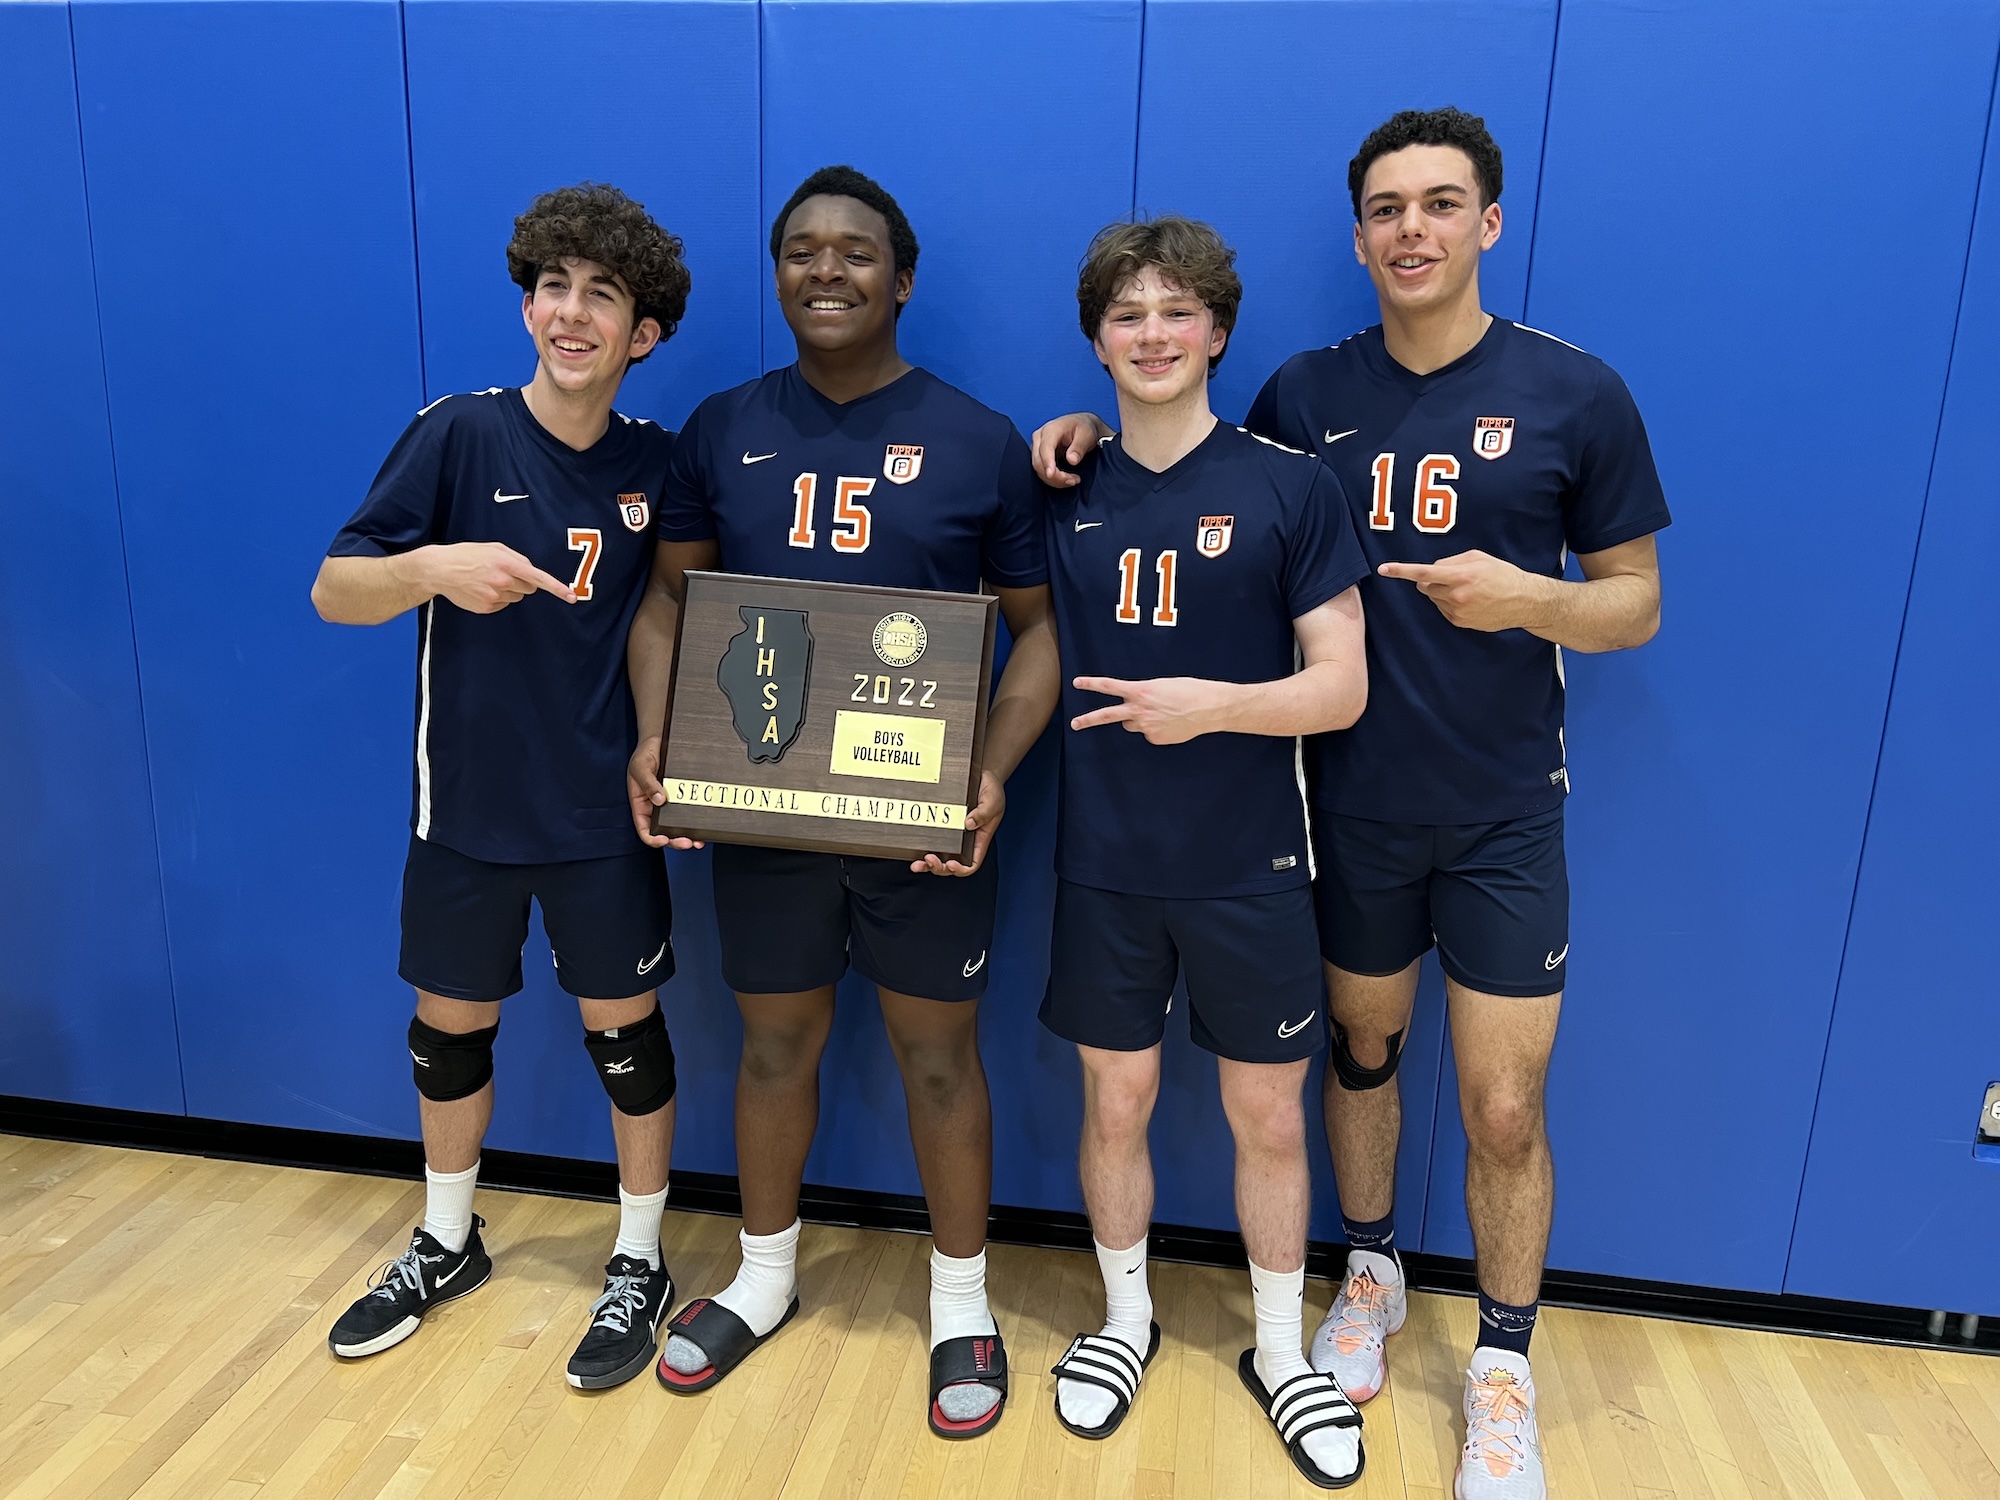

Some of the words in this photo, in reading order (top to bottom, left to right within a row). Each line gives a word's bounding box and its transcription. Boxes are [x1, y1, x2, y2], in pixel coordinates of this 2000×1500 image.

[1481, 418, 1508, 428] OPRF
[891, 446, 919, 456] OPRF
[1369, 453, 1461, 533] 16
[788, 471, 877, 554] 15
[1203, 517, 1229, 527] OPRF
[567, 527, 602, 601] 7
[1115, 548, 1178, 627] 11
[893, 614, 912, 622] HIGH
[876, 647, 920, 665] ASSOCIATION
[755, 616, 780, 745] IHSA
[850, 673, 938, 709] 2022
[873, 730, 904, 746] BOYS
[852, 745, 922, 766] VOLLEYBALL
[676, 782, 800, 811] SECTIONAL
[821, 794, 952, 825] CHAMPIONS
